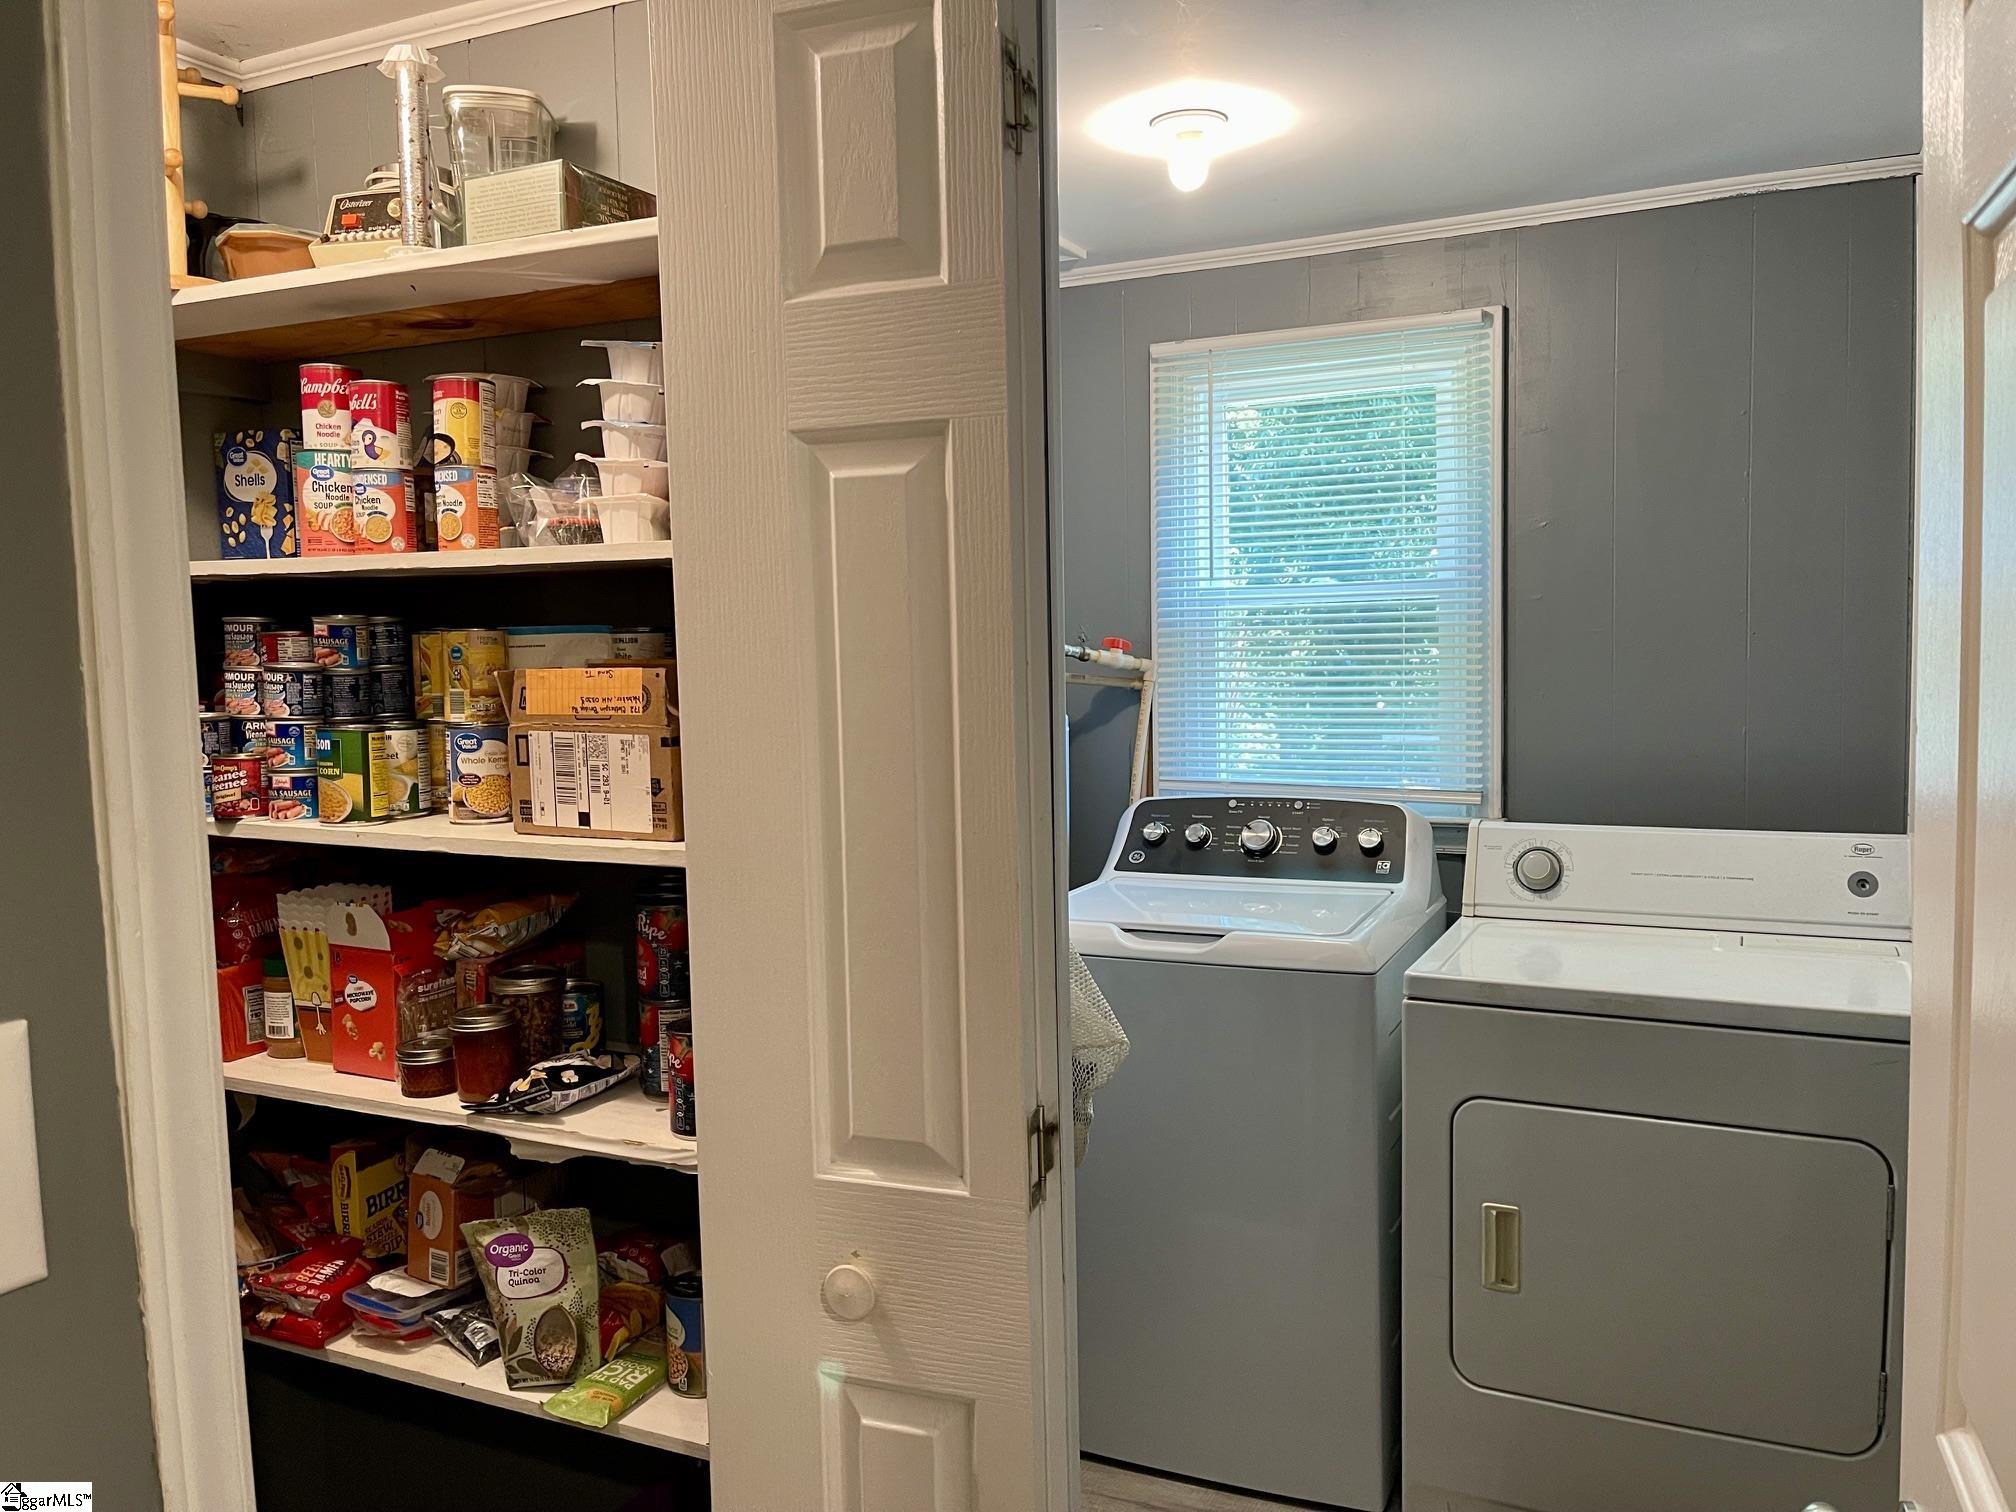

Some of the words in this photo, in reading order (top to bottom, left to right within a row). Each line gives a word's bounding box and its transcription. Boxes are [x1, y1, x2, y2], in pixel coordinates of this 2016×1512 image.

[339, 199, 374, 211] Osterizer
[300, 378, 350, 397] Campbe
[349, 393, 378, 410] bell's
[315, 422, 342, 431] Chicken
[316, 430, 341, 438] Noodle
[314, 452, 352, 468] HEARTY
[234, 473, 266, 488] Shells
[311, 480, 353, 493] Chicken
[325, 492, 350, 502] Noodle
[354, 495, 382, 505] Chicken
[442, 499, 463, 507] Noodle
[313, 501, 334, 509] SOUP
[319, 638, 349, 646] SAUSAGE
[316, 738, 331, 751] son
[456, 737, 477, 747] Great
[460, 757, 486, 765] Whole
[601, 762, 609, 772] SC
[319, 767, 340, 776] CORN
[602, 774, 610, 787] 293
[279, 789, 312, 797] SAUSAGE
[637, 910, 668, 941] Ripe
[465, 969, 477, 992] RITZ
[366, 1180, 408, 1219] BIRR
[489, 1241, 529, 1257] Organic
[508, 1267, 547, 1278] Tri-Color
[508, 1276, 540, 1288] Quinoa
[609, 1377, 636, 1391] PAD
